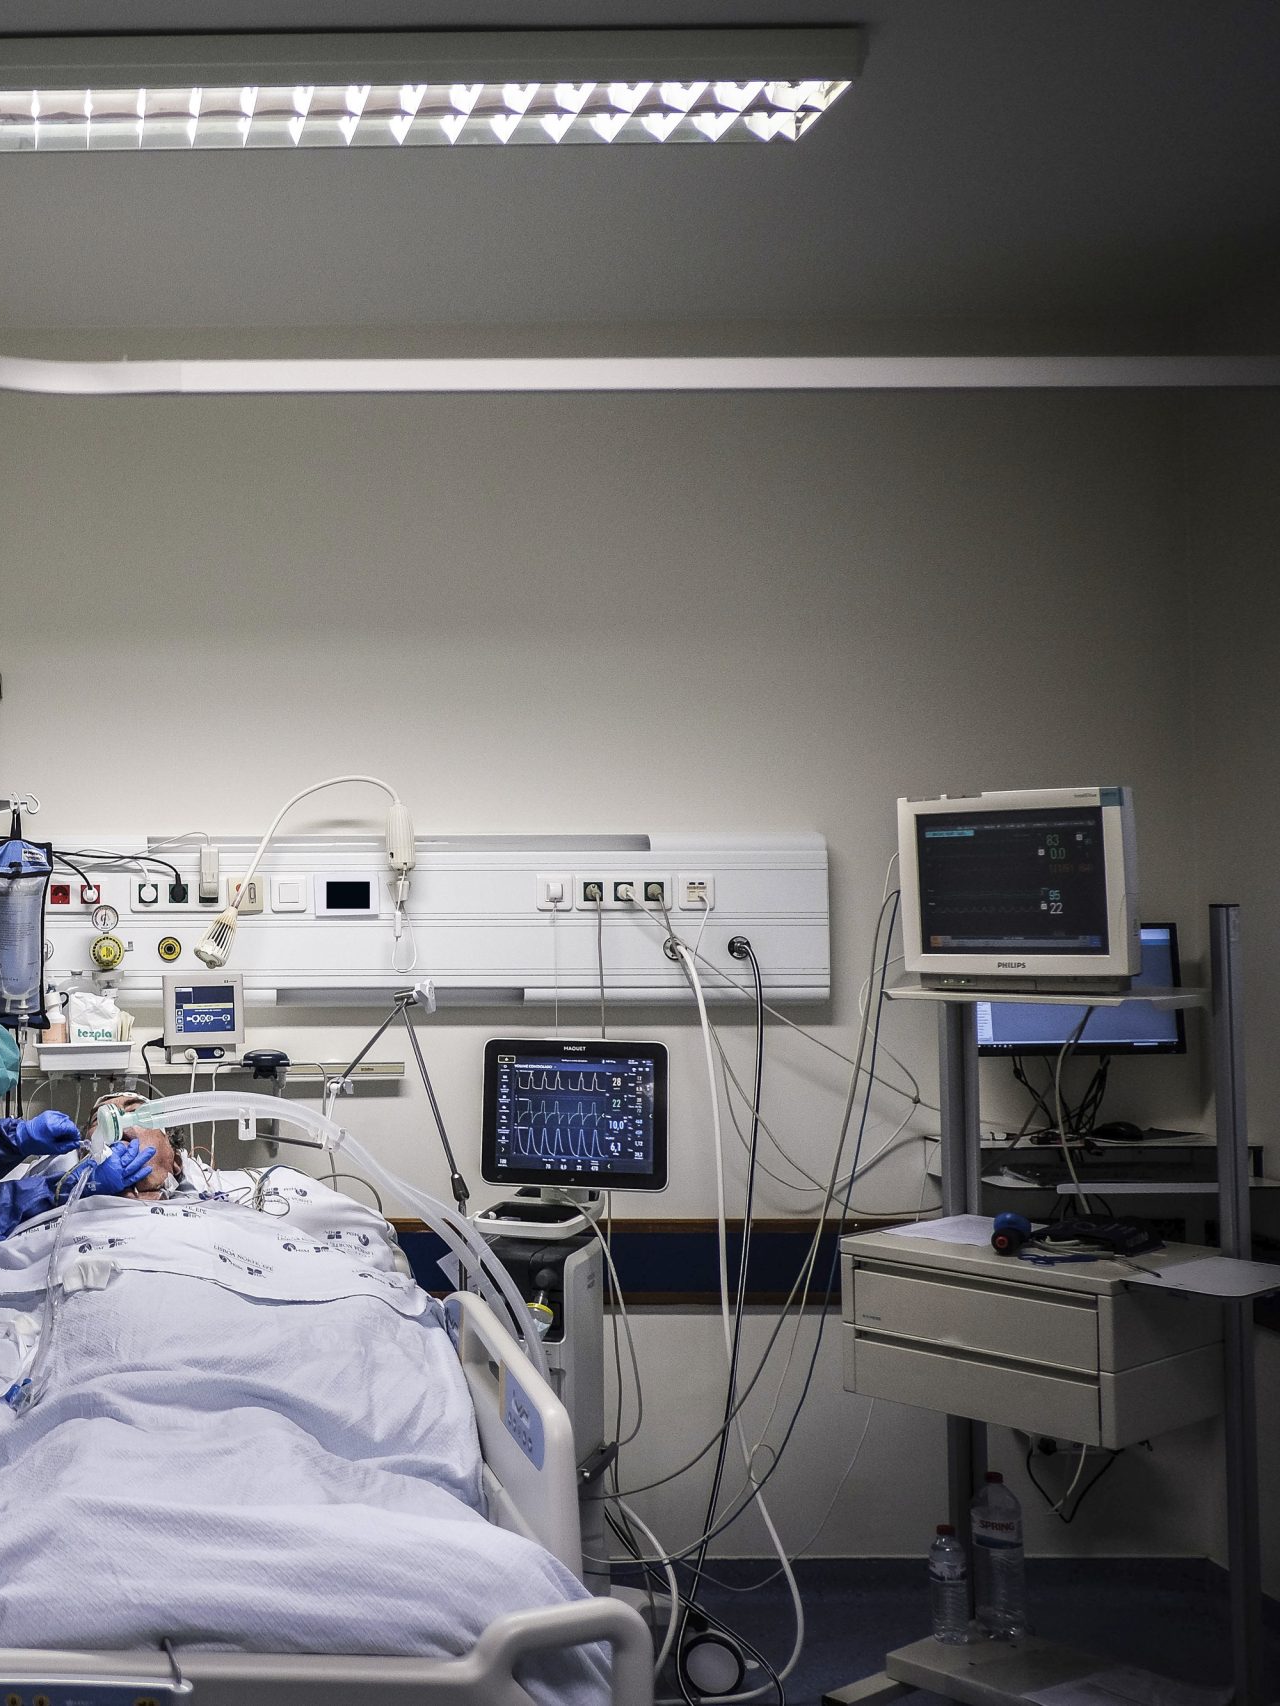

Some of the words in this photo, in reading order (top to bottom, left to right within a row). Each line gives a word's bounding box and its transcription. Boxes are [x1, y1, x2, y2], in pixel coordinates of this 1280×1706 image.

[1046, 834, 1059, 846] 83
[1049, 890, 1060, 900] 95
[1050, 902, 1063, 914] 22
[612, 1077, 622, 1086] 28
[612, 1099, 622, 1108] 22
[609, 1120, 624, 1130] 10,0
[610, 1142, 621, 1152] 6,1
[978, 1519, 1016, 1532] SPRING
